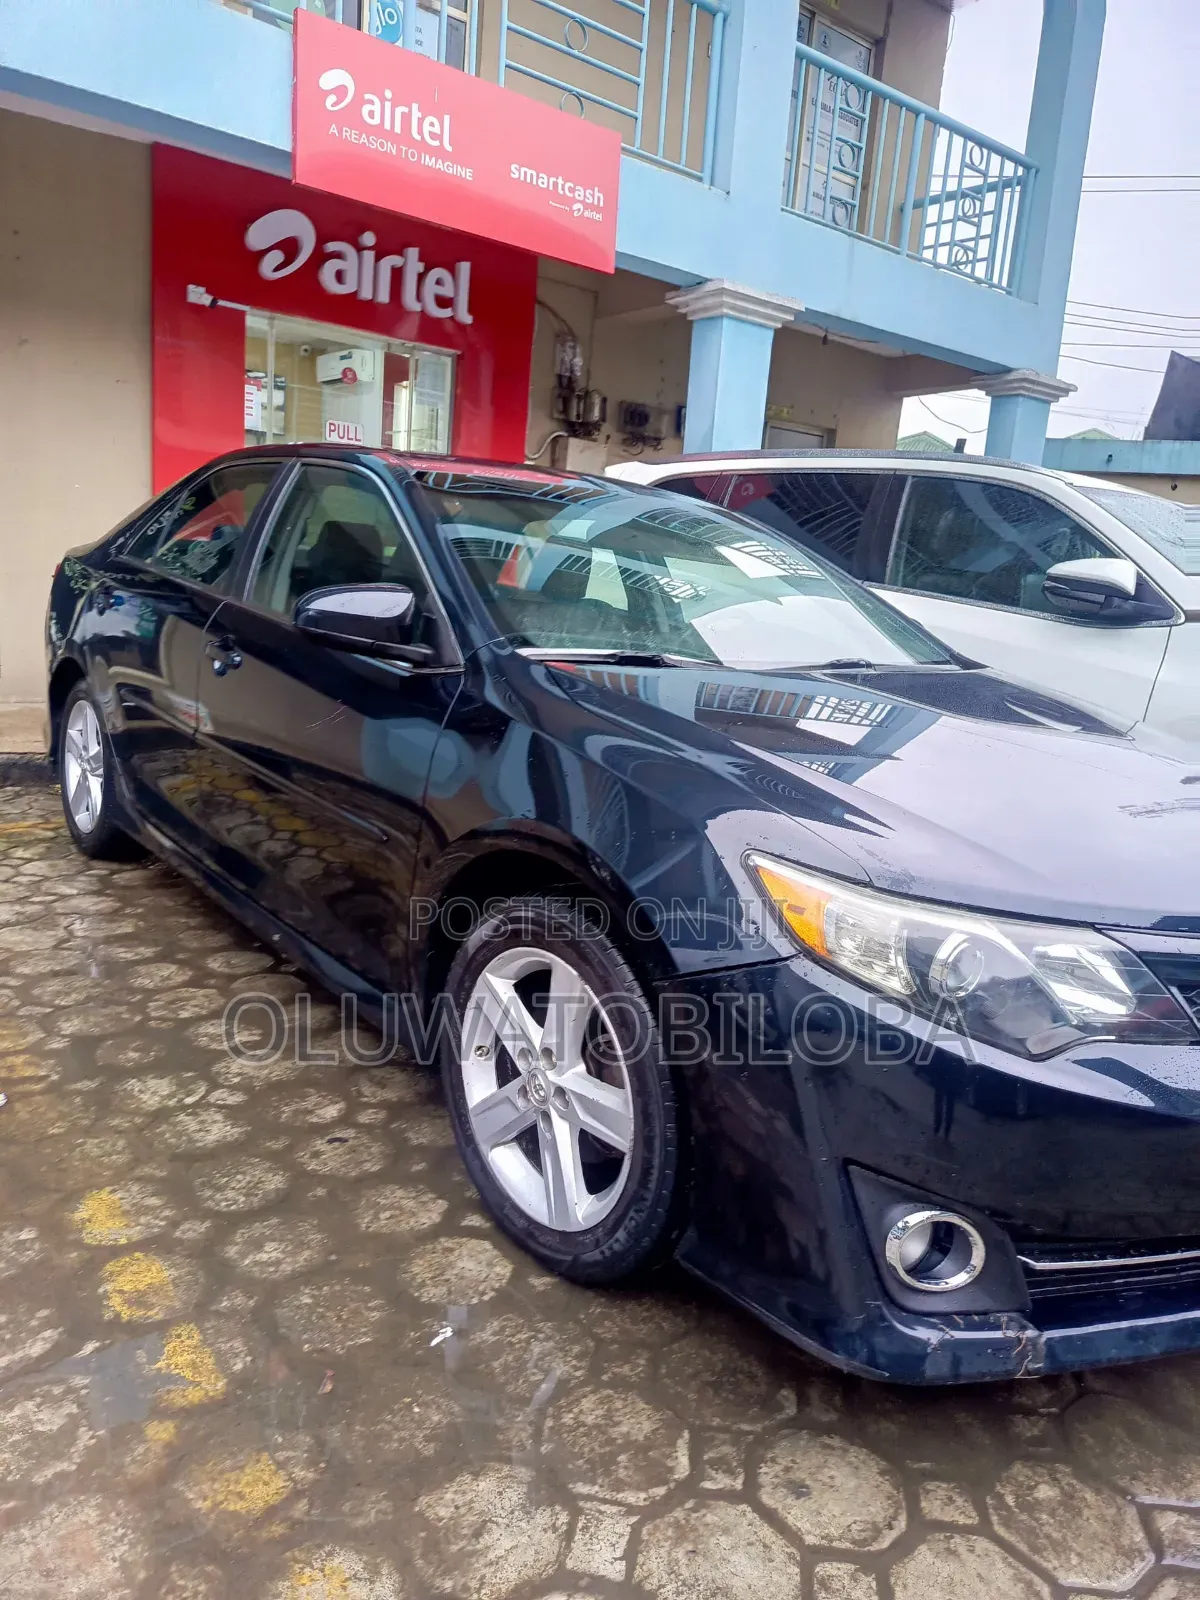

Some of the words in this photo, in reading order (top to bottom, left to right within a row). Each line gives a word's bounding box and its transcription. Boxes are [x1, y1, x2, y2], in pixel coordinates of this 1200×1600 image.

[361, 88, 453, 152] airtel
[328, 123, 339, 137] A
[342, 126, 397, 156] REASON
[400, 145, 418, 162] TO
[420, 153, 474, 181] IMAGINE
[510, 163, 604, 207] smartcash
[583, 208, 603, 222] airtel
[318, 230, 474, 325] airtel
[328, 422, 362, 442] PULL
